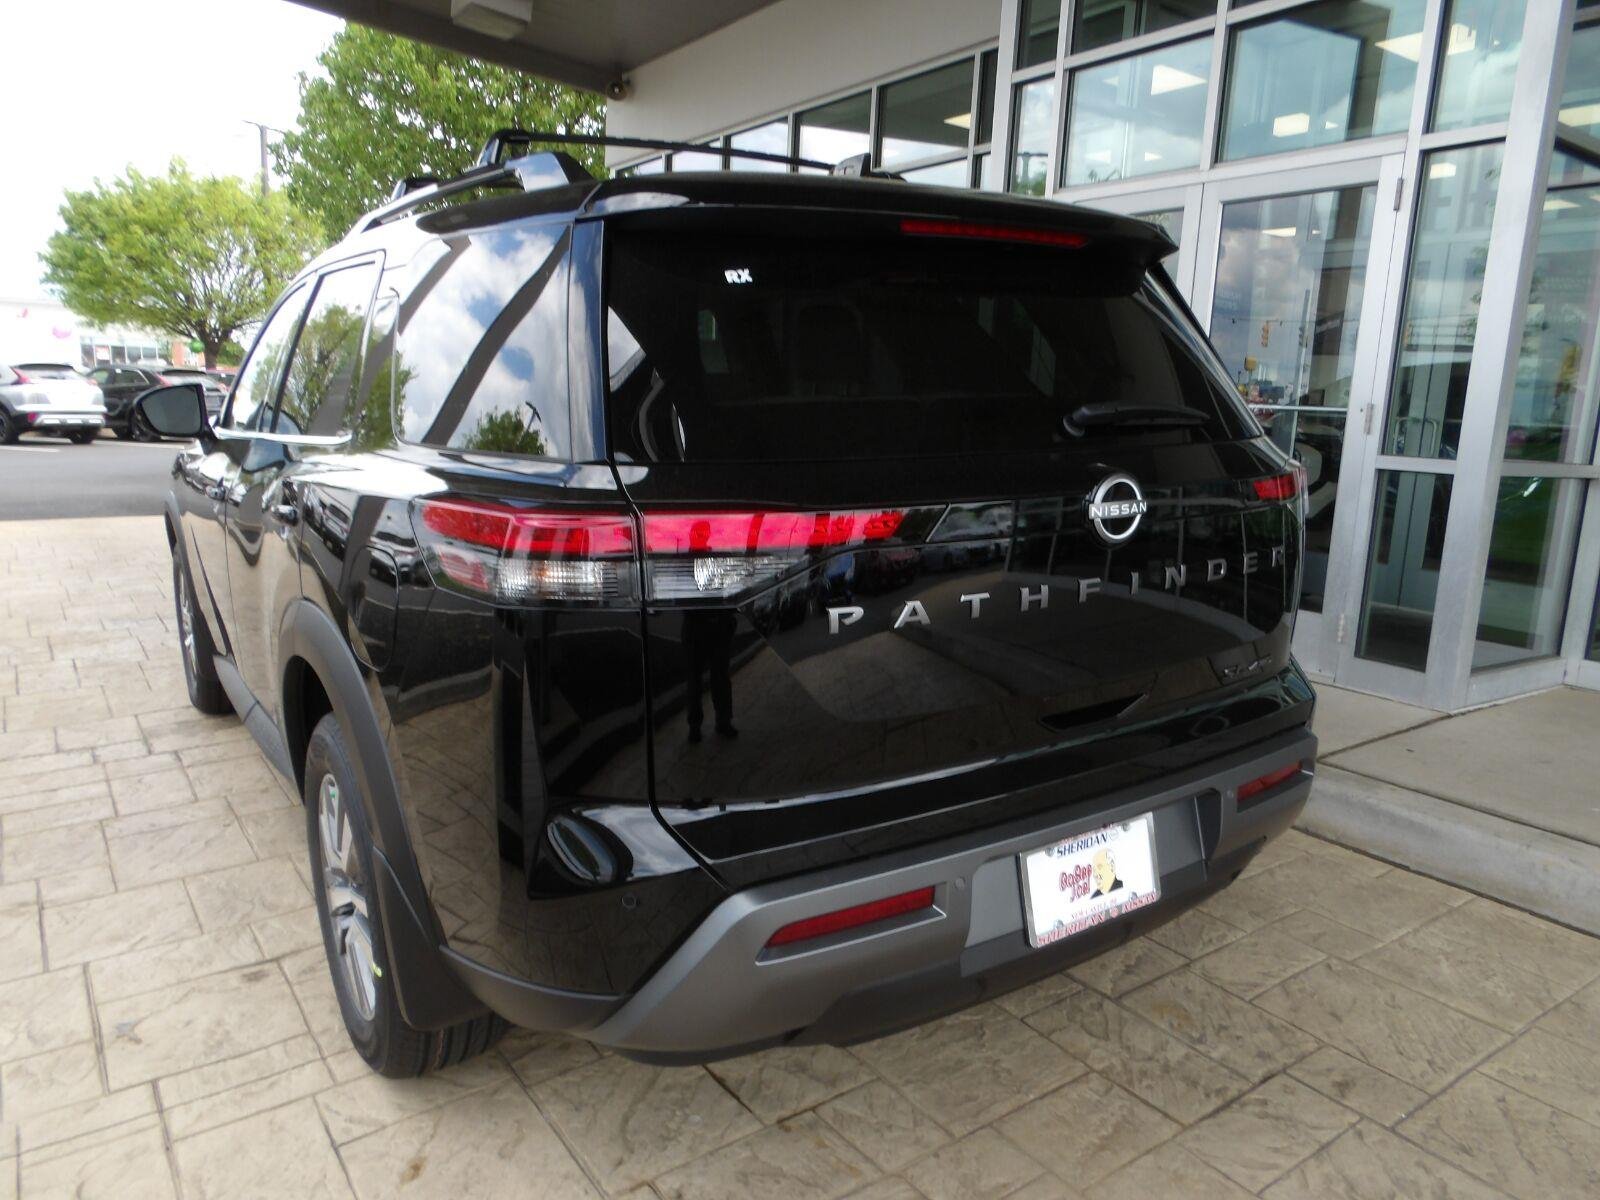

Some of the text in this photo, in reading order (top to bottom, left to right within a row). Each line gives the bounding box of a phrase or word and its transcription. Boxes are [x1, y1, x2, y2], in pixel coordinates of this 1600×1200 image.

[724, 267, 753, 284] RX
[1091, 501, 1147, 517] NISSAN
[827, 545, 1285, 635] PATHFINDER
[1057, 833, 1108, 858] SHERIDAN
